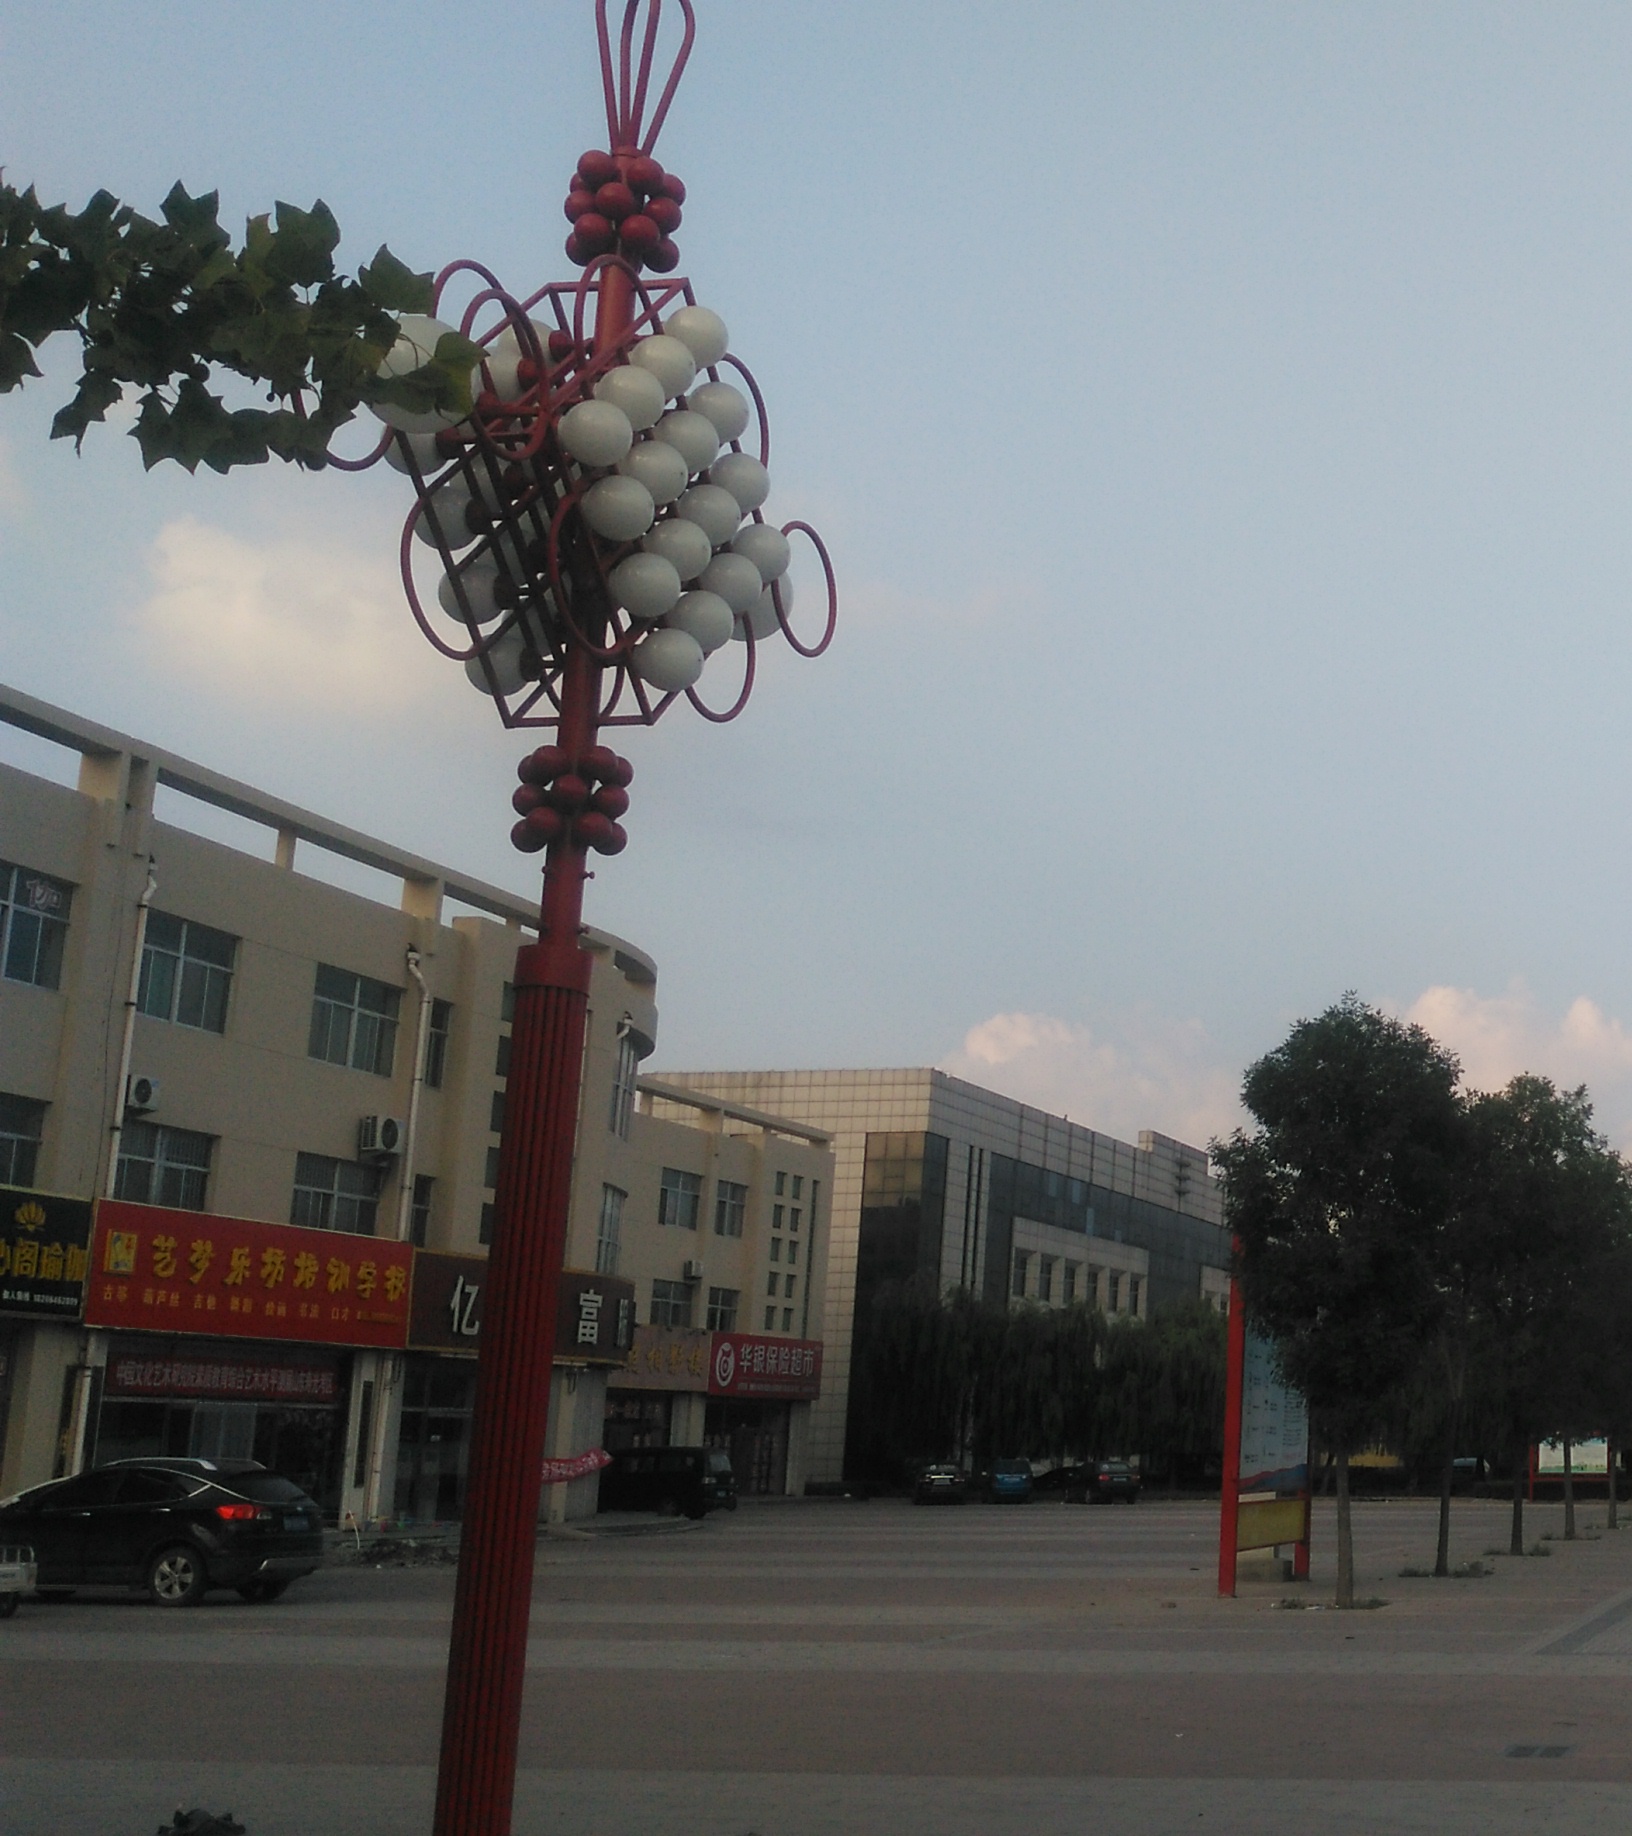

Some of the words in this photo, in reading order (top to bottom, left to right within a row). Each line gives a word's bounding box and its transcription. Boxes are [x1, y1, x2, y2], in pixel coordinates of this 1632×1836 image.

[151, 1234, 408, 1302] 艺梦乐坊培训学校
[577, 1288, 604, 1345] 富
[739, 1344, 815, 1376] 华银保险超市
